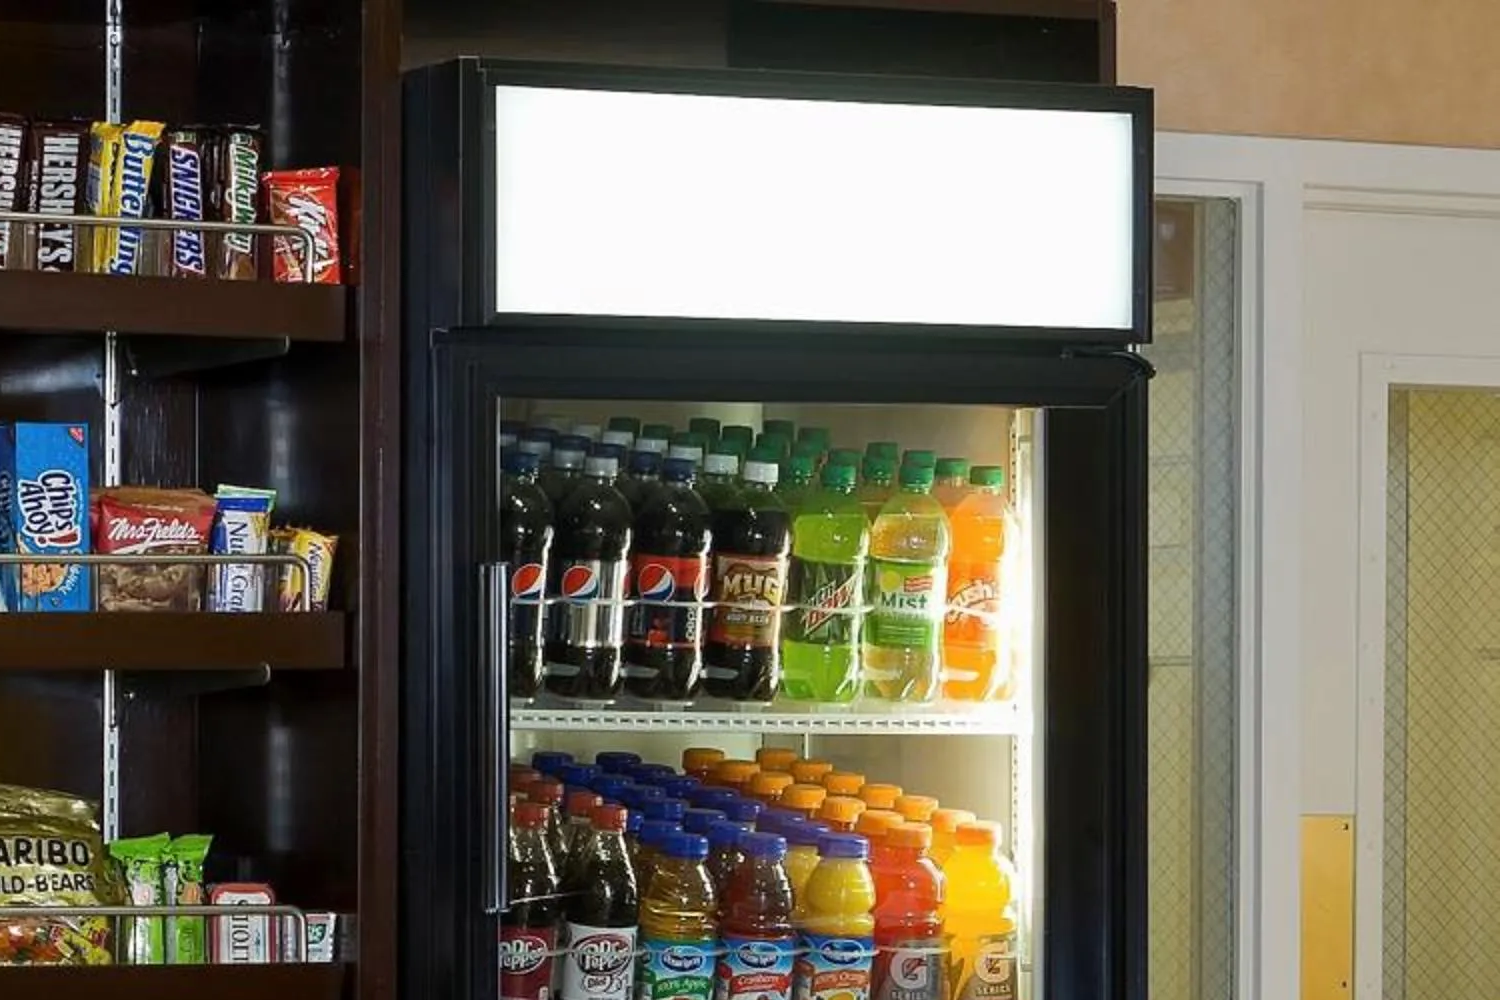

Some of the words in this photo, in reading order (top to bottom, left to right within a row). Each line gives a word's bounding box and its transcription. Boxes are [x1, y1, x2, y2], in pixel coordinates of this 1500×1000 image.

[38, 133, 79, 263] HERSHY'S
[39, 471, 76, 531] Chips
[227, 575, 249, 612] Grai
[723, 574, 781, 604] MUG
[881, 591, 926, 609] Mist
